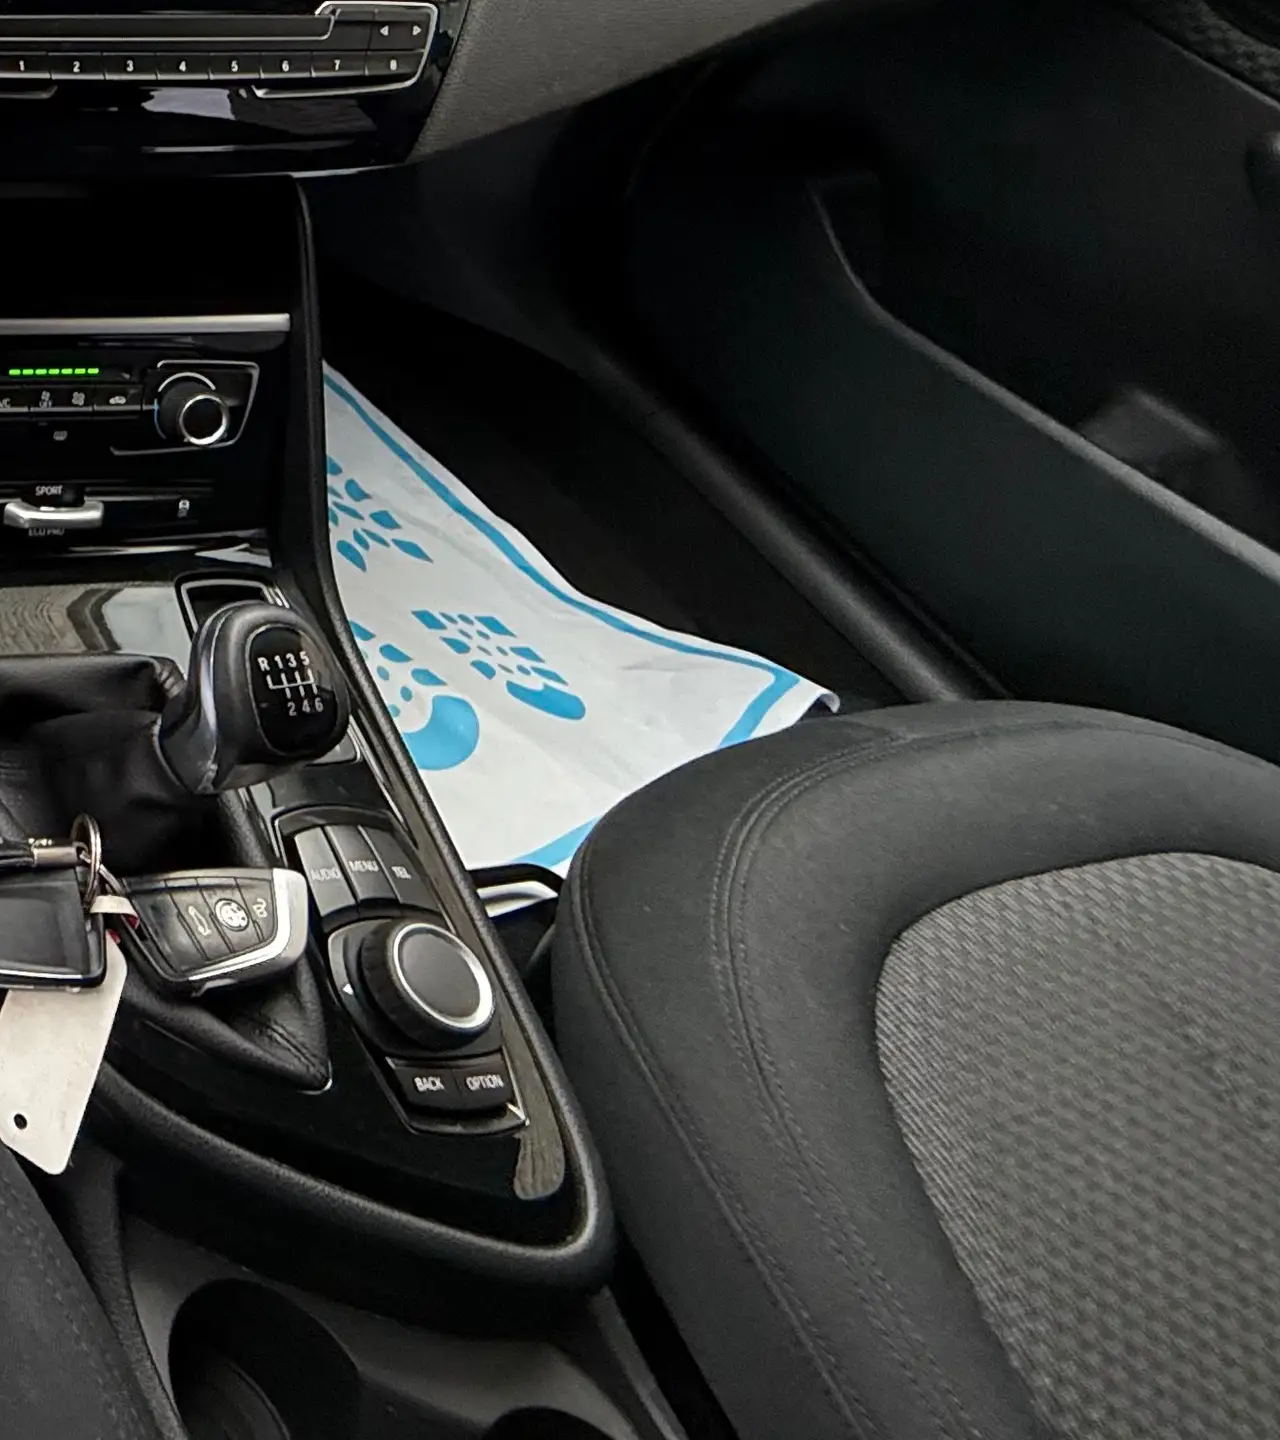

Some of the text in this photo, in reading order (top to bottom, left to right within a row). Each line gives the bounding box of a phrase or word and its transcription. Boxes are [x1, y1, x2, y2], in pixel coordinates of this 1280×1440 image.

[18, 59, 25, 72] 1
[72, 60, 80, 73] 2
[126, 59, 134, 73] 3
[178, 59, 187, 72] 4
[230, 59, 239, 72] 5
[282, 59, 290, 72] 6
[333, 59, 341, 71] 7
[389, 59, 397, 71] 8
[35, 485, 63, 496] SPORT
[257, 651, 310, 672] R 1 3 5
[287, 697, 324, 716] 2 4 6
[348, 860, 379, 872] MENU
[310, 867, 342, 881] AUDIO
[414, 1076, 445, 1092] BACK
[466, 1074, 505, 1091] OPTION
